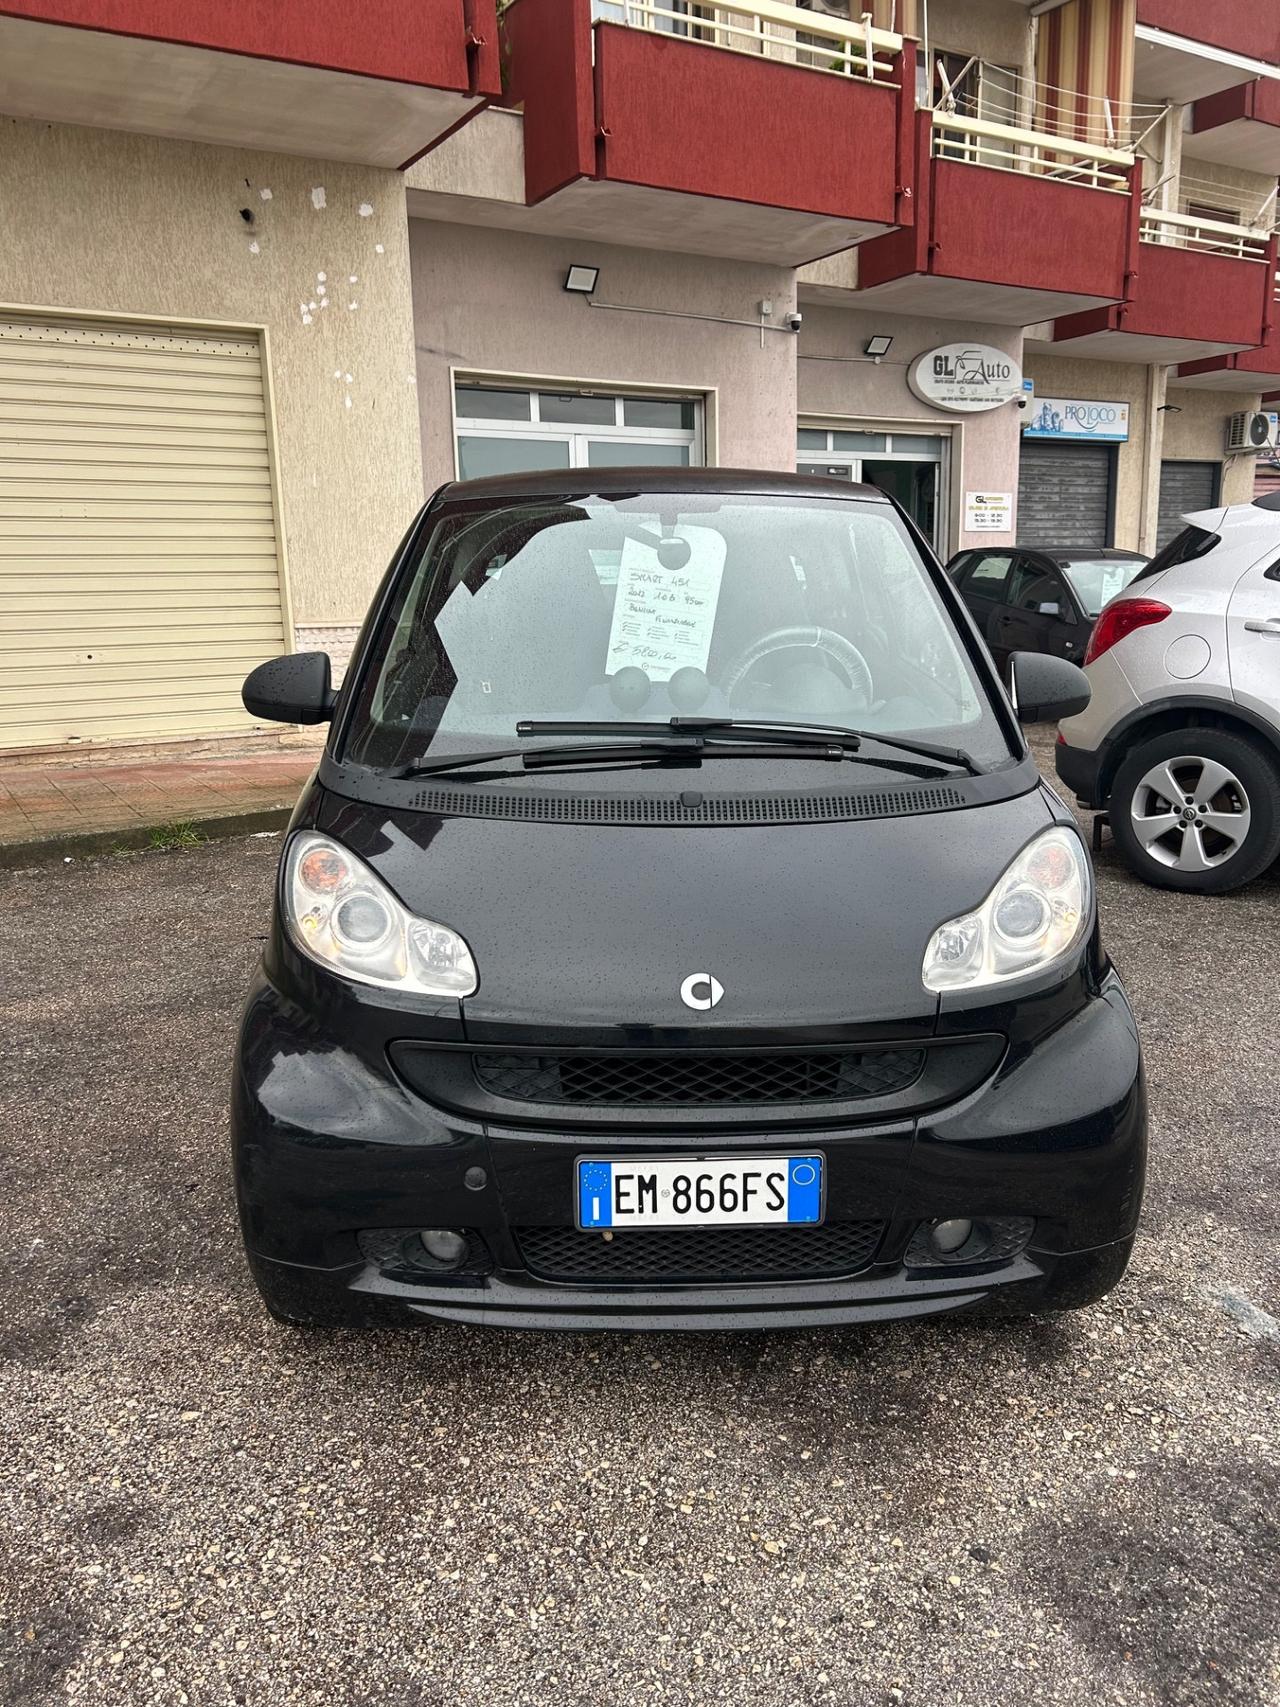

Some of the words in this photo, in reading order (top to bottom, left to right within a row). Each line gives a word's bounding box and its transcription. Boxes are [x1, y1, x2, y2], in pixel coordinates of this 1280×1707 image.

[933, 355, 953, 376] GL
[963, 357, 1010, 384] Auto
[614, 1174, 658, 1214] EM
[672, 1172, 786, 1214] 866FS
